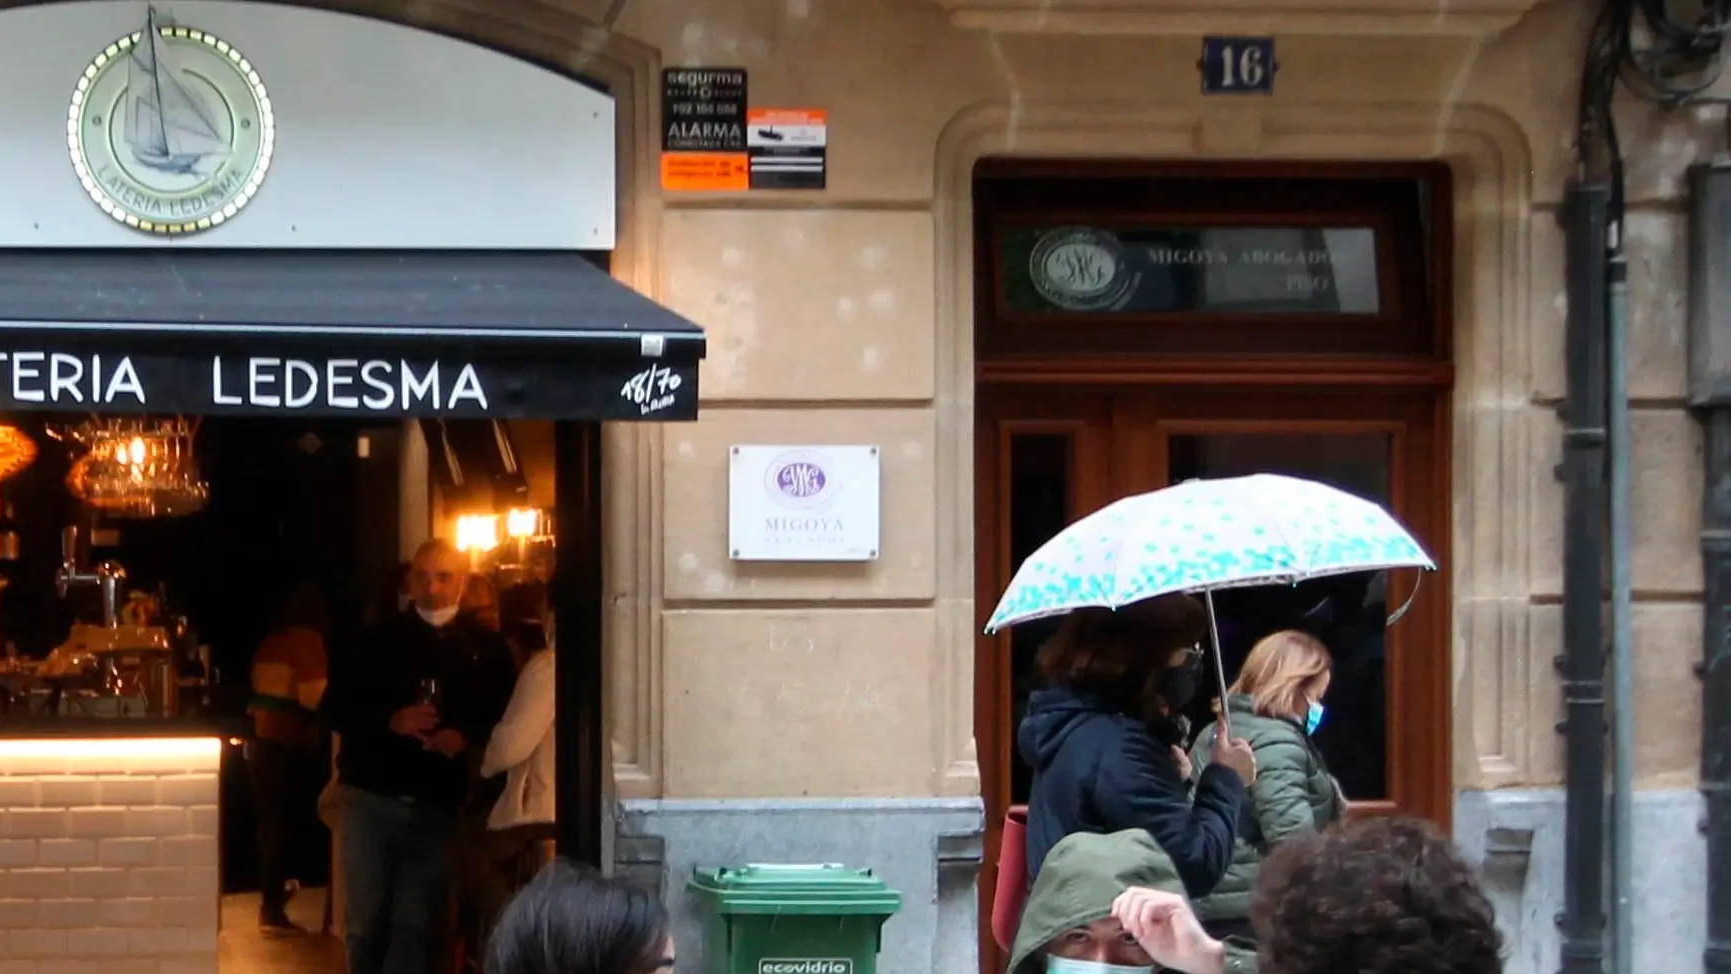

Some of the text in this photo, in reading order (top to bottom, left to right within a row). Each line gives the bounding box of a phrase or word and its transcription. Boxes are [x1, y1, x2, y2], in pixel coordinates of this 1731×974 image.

[1221, 46, 1263, 86] 16
[668, 72, 742, 87] segurma
[669, 122, 741, 138] ALARMA
[1148, 248, 1229, 265] MIGOYA
[213, 356, 489, 411] LEDESMA
[620, 363, 682, 404] 18/70
[765, 517, 844, 533] MIGOYA
[762, 960, 846, 974] ecovidrio
